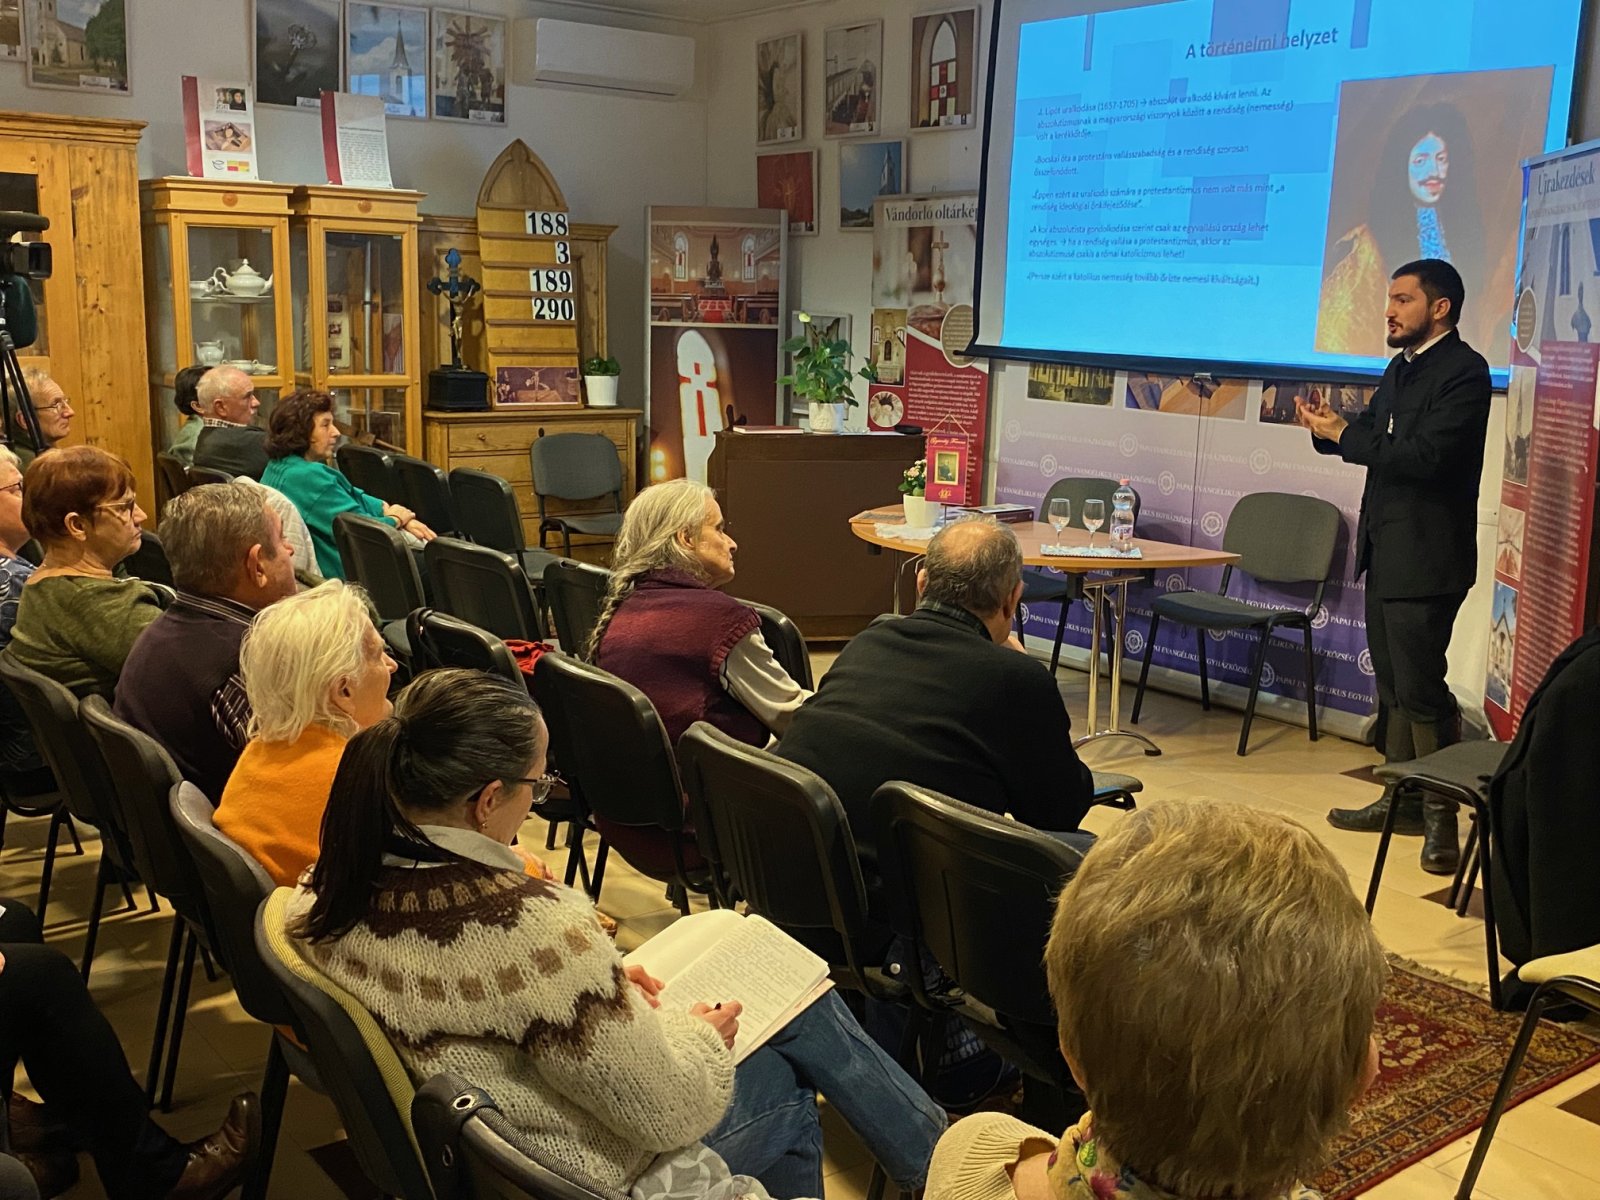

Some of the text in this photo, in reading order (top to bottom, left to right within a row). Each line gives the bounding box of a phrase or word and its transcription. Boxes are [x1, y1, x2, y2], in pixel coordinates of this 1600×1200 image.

[1185, 27, 1339, 60] A történelmi helyzet
[1097, 99, 1138, 112] (1657-1705)
[1261, 87, 1272, 97] Az
[1098, 112, 1146, 125] magyarországi
[1147, 108, 1181, 121] viszonyok
[1246, 100, 1294, 113] (nemesség)
[1142, 184, 1202, 197] protestantizmus
[1203, 186, 1219, 194] nem
[1221, 184, 1235, 193] volt
[1254, 182, 1274, 192] mint
[528, 212, 567, 236] 188
[885, 205, 933, 221] Vándorló
[557, 242, 569, 264] 3
[532, 269, 571, 293] 189
[533, 298, 573, 321] 290
[1330, 615, 1351, 626] PÁPAI
[1161, 648, 1200, 663] EVANGÉLIKU
[1206, 657, 1253, 676] GYHÁZKÖZSÉG
